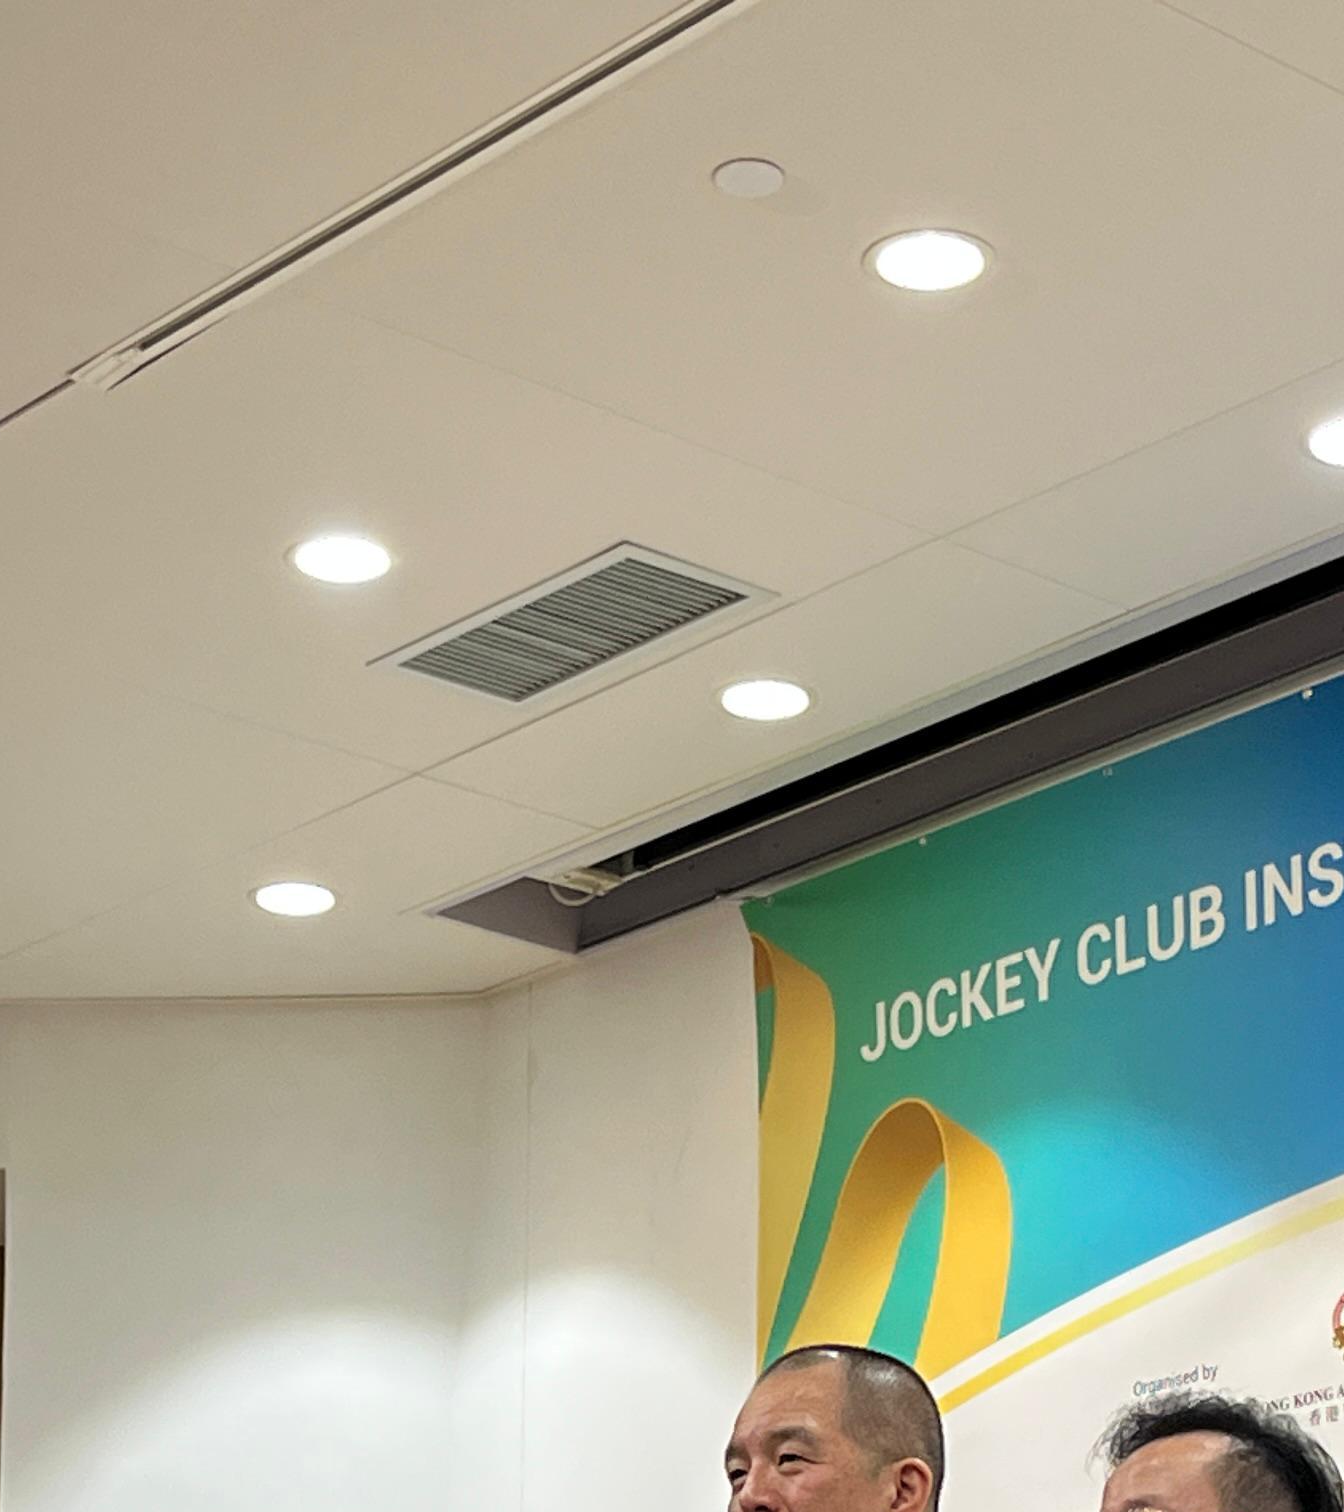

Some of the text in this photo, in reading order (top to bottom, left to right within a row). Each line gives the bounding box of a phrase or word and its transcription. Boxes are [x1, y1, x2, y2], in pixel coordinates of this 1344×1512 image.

[860, 938, 1060, 1063] JOCKEY
[1076, 883, 1226, 987] CLUB
[1132, 1363, 1218, 1397] Organised by
[1293, 1386, 1334, 1409] KONG
